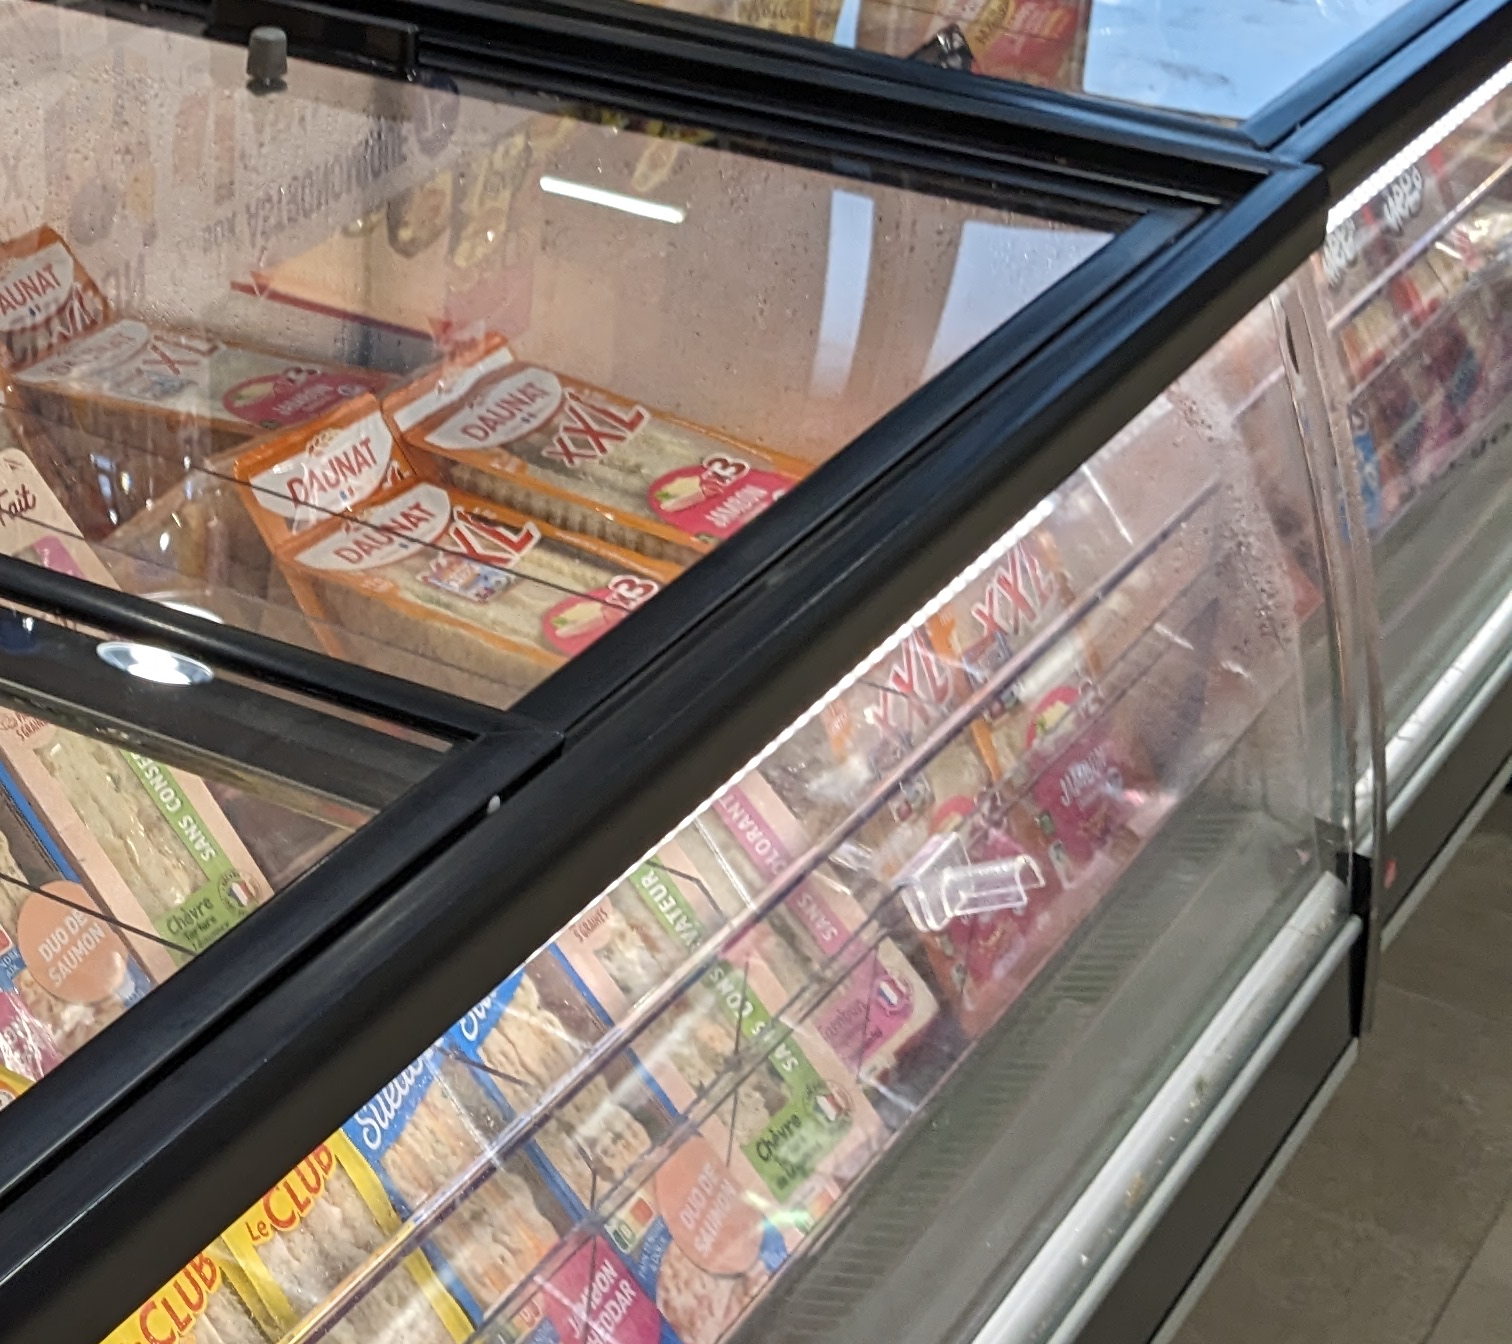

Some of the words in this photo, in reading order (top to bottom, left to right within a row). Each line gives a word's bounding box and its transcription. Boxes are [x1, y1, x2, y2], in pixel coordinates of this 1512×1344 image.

[461, 381, 548, 443] DAUNAT
[543, 387, 648, 467] XXL
[289, 436, 380, 506] DAUNAT
[37, 928, 68, 964] DUO
[46, 926, 107, 989] SAUMON
[244, 1219, 269, 1243] Le
[261, 1140, 338, 1231] CLUB
[692, 1183, 739, 1258] SAUMON
